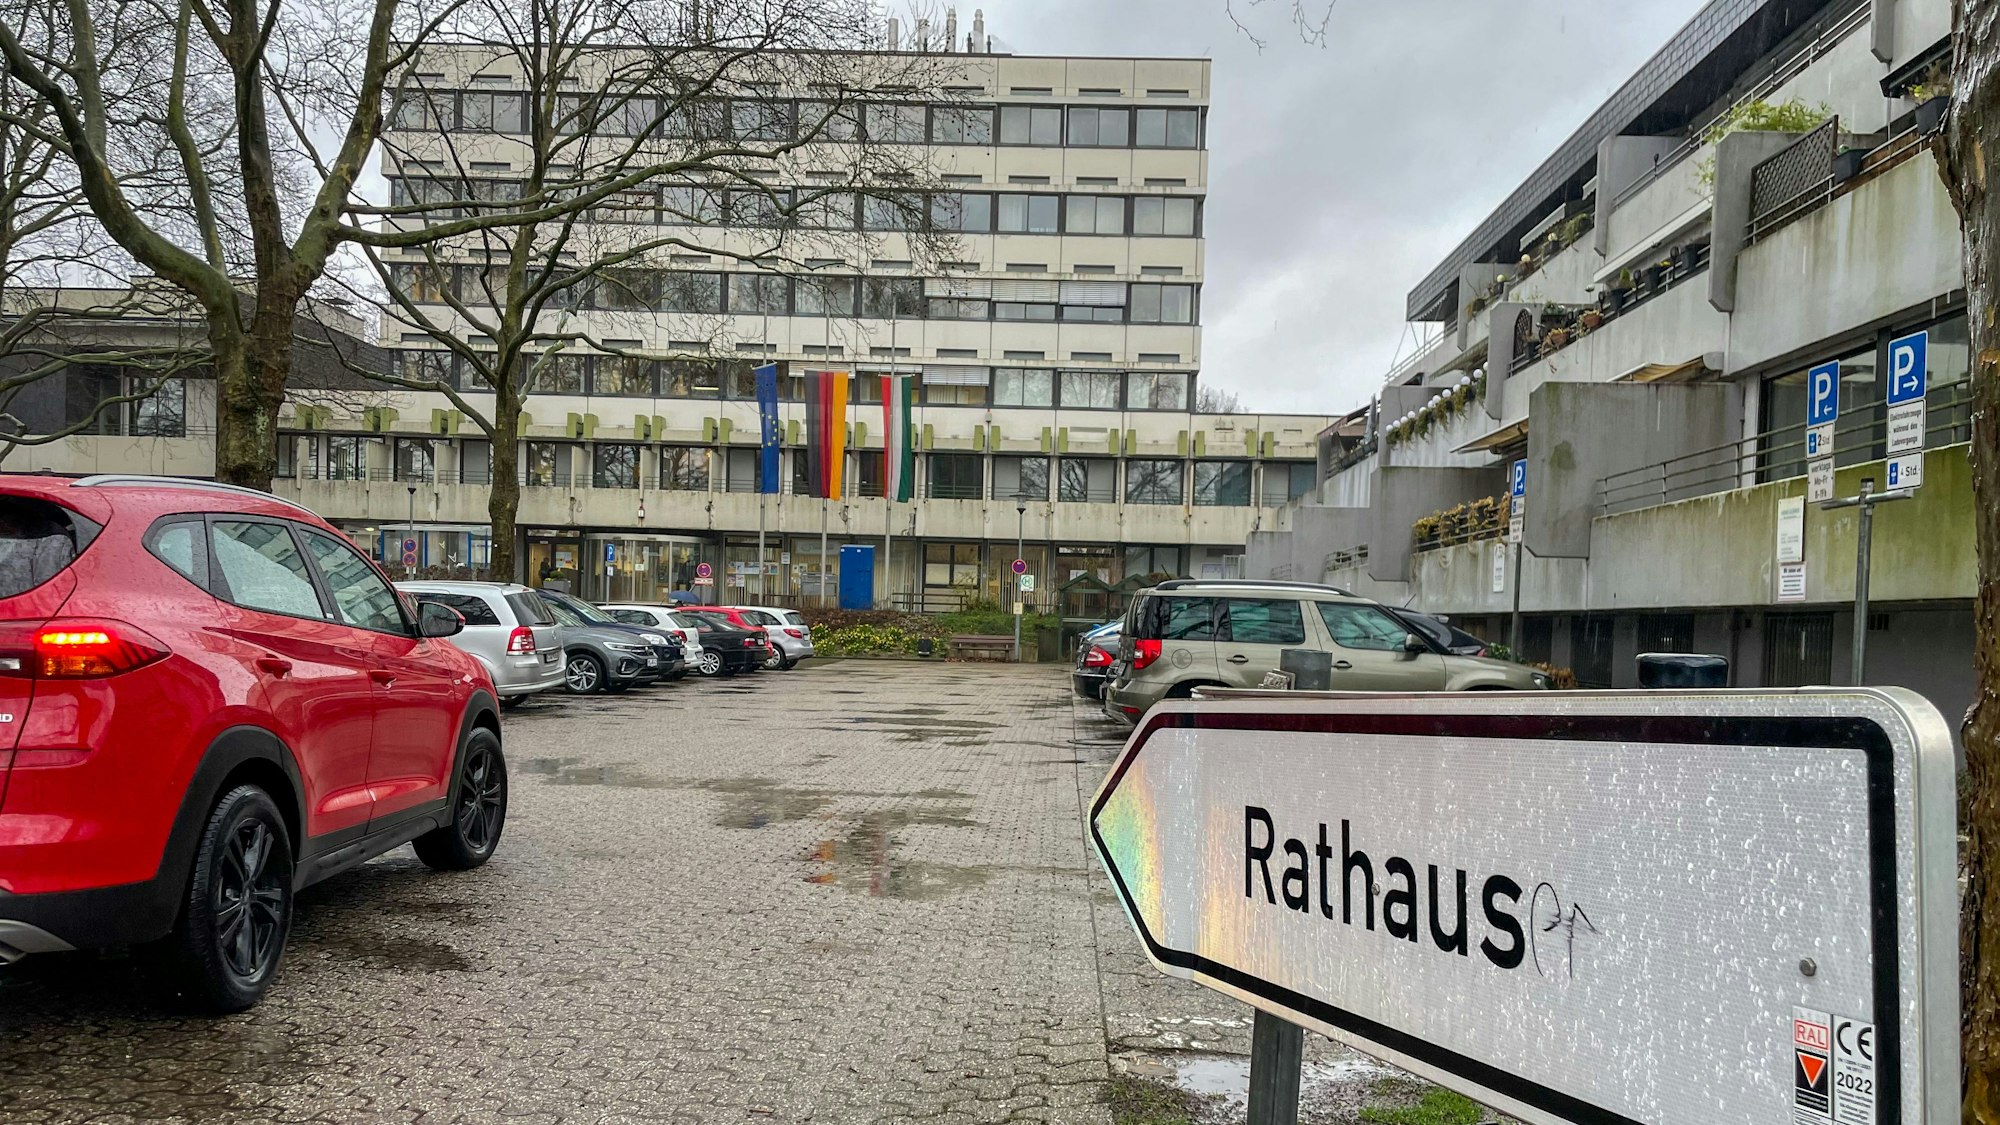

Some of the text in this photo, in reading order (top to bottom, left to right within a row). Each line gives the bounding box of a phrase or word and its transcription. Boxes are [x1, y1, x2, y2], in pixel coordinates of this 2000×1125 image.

[1893, 345, 1915, 396] P
[1814, 372, 1832, 419] P
[1817, 434, 1822, 446] 2
[1514, 465, 1523, 493] P
[1811, 461, 1831, 473] werktags
[1905, 465, 1919, 477] Std.
[608, 545, 613, 561] P
[1245, 805, 1526, 970] Rathaus
[1797, 1024, 1825, 1046] RAL
[1836, 1021, 1872, 1061] CE
[1837, 1071, 1873, 1095] 2022
